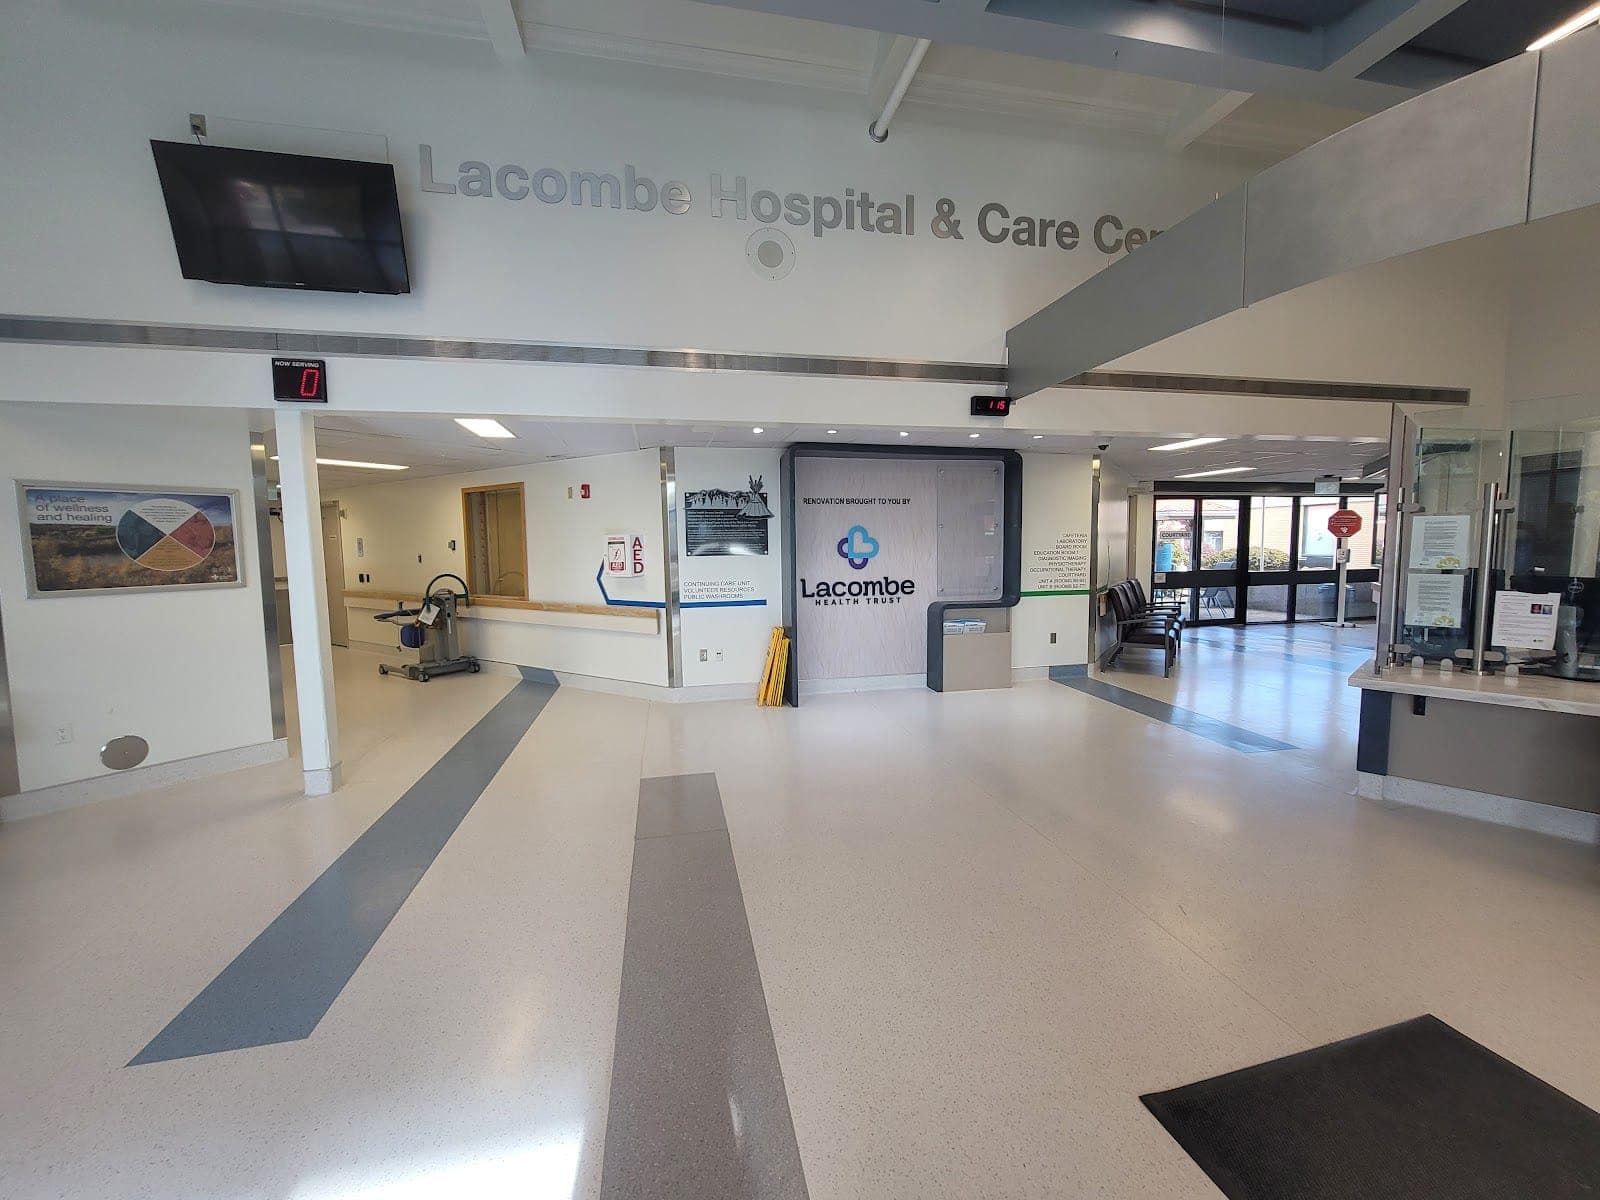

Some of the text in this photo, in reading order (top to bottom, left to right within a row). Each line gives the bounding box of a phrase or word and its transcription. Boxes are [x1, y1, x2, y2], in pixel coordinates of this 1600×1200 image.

[419, 144, 692, 216] Lacombe
[710, 172, 916, 238] Hospital
[929, 197, 964, 242] &
[975, 202, 1080, 250] Care
[300, 368, 320, 397] 0
[49, 495, 86, 503] place
[802, 497, 911, 505] RENOVATION BROUGHT TO YOU BY
[36, 503, 109, 513] of wellness
[37, 513, 112, 523] and healing
[632, 536, 645, 574] AED
[800, 576, 915, 599] Lacombe
[815, 596, 903, 606] HEALTH TRUST
